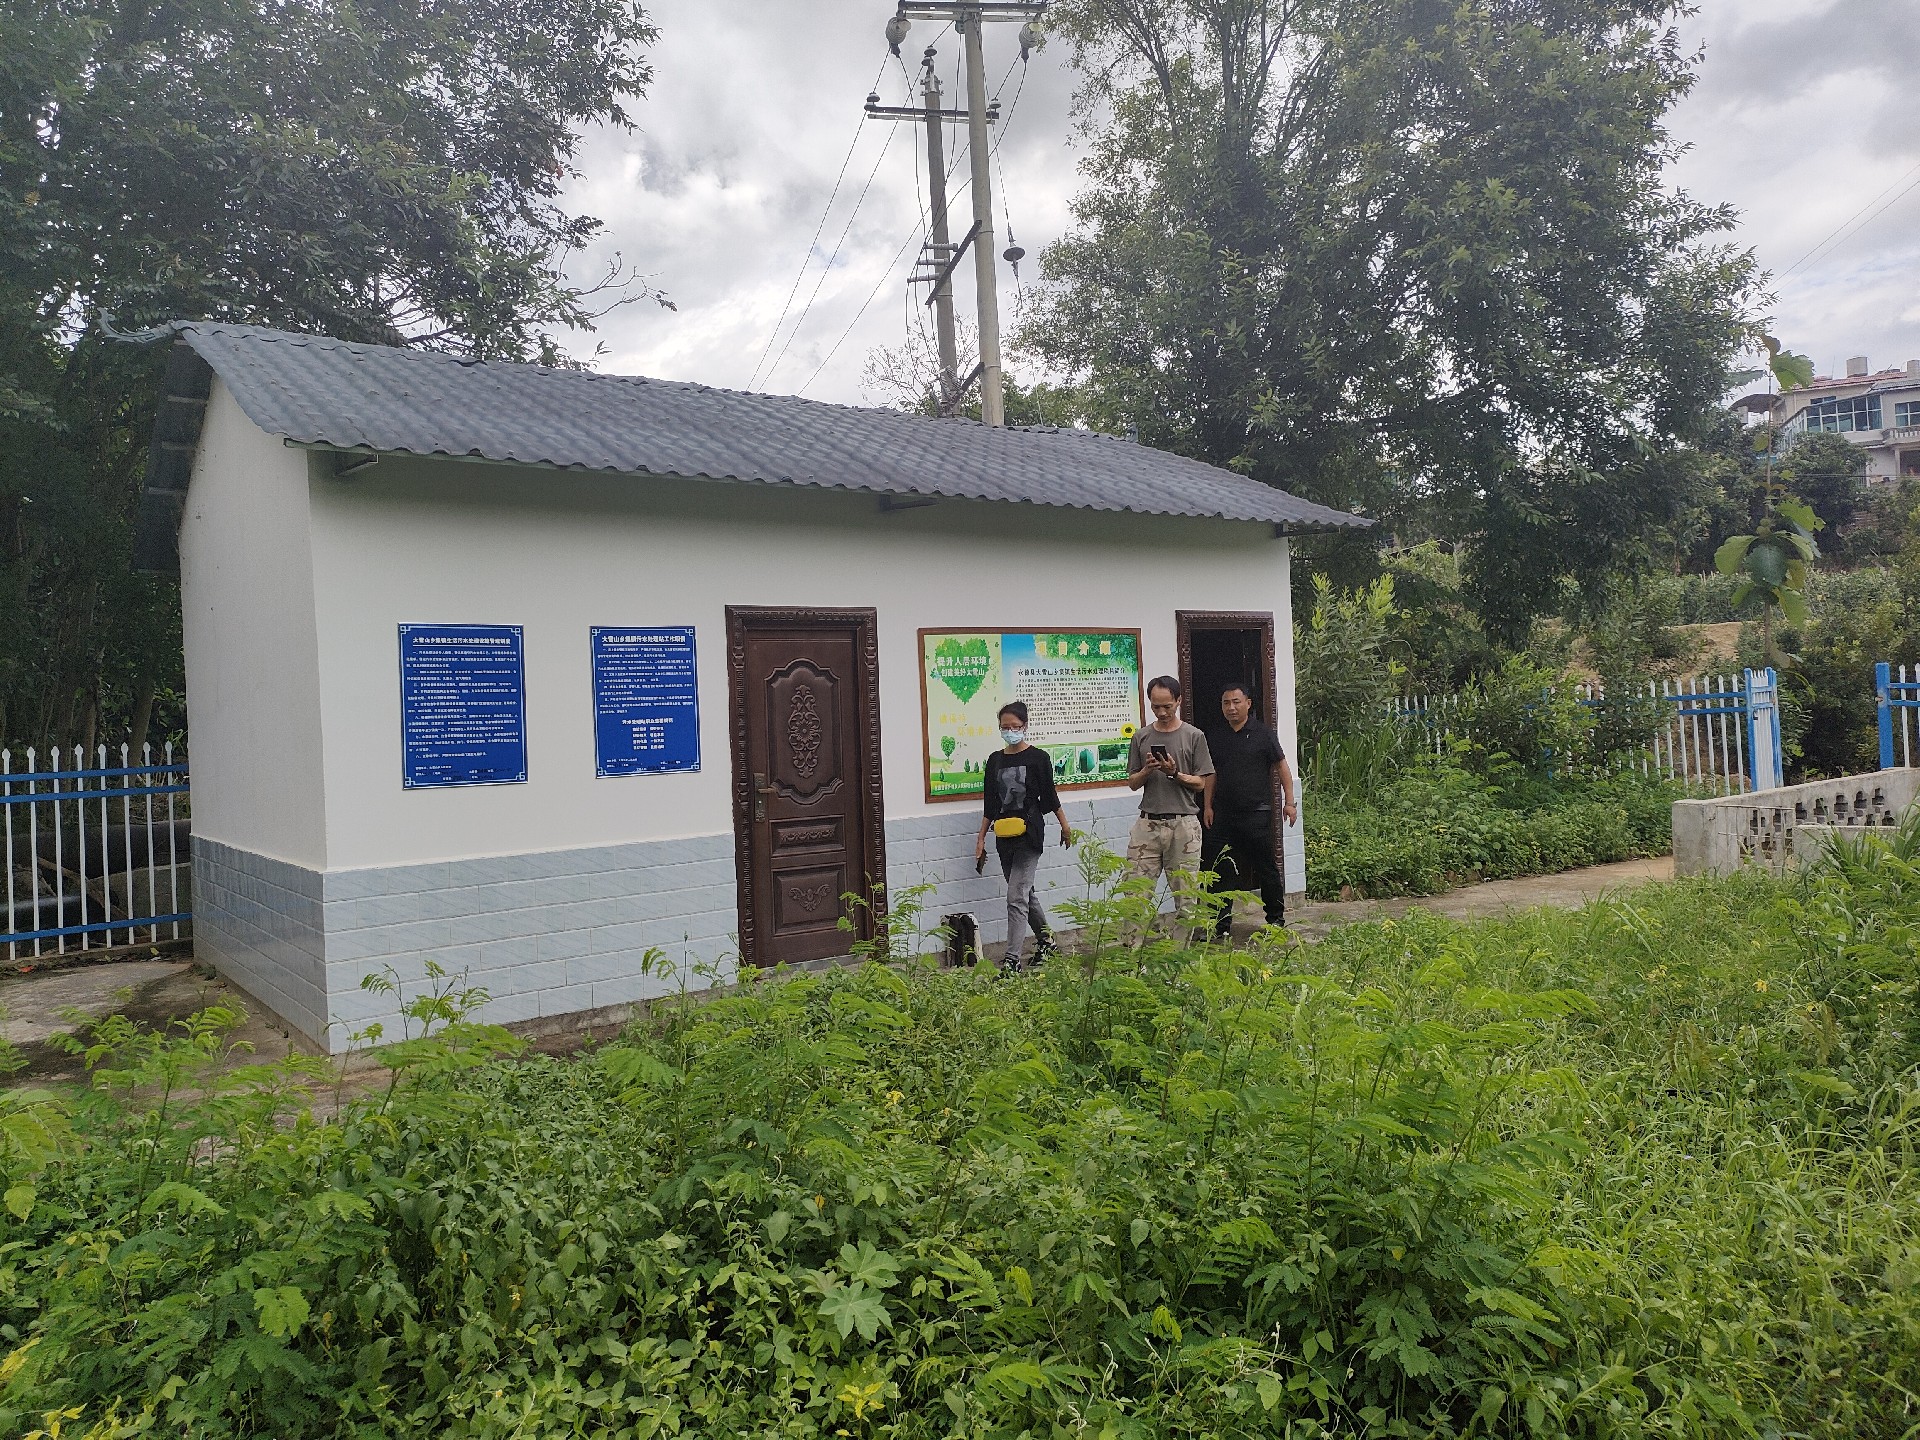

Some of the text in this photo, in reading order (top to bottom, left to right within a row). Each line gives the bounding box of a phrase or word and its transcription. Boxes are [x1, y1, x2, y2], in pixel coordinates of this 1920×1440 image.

[937, 655, 987, 667] 提升人居环境
